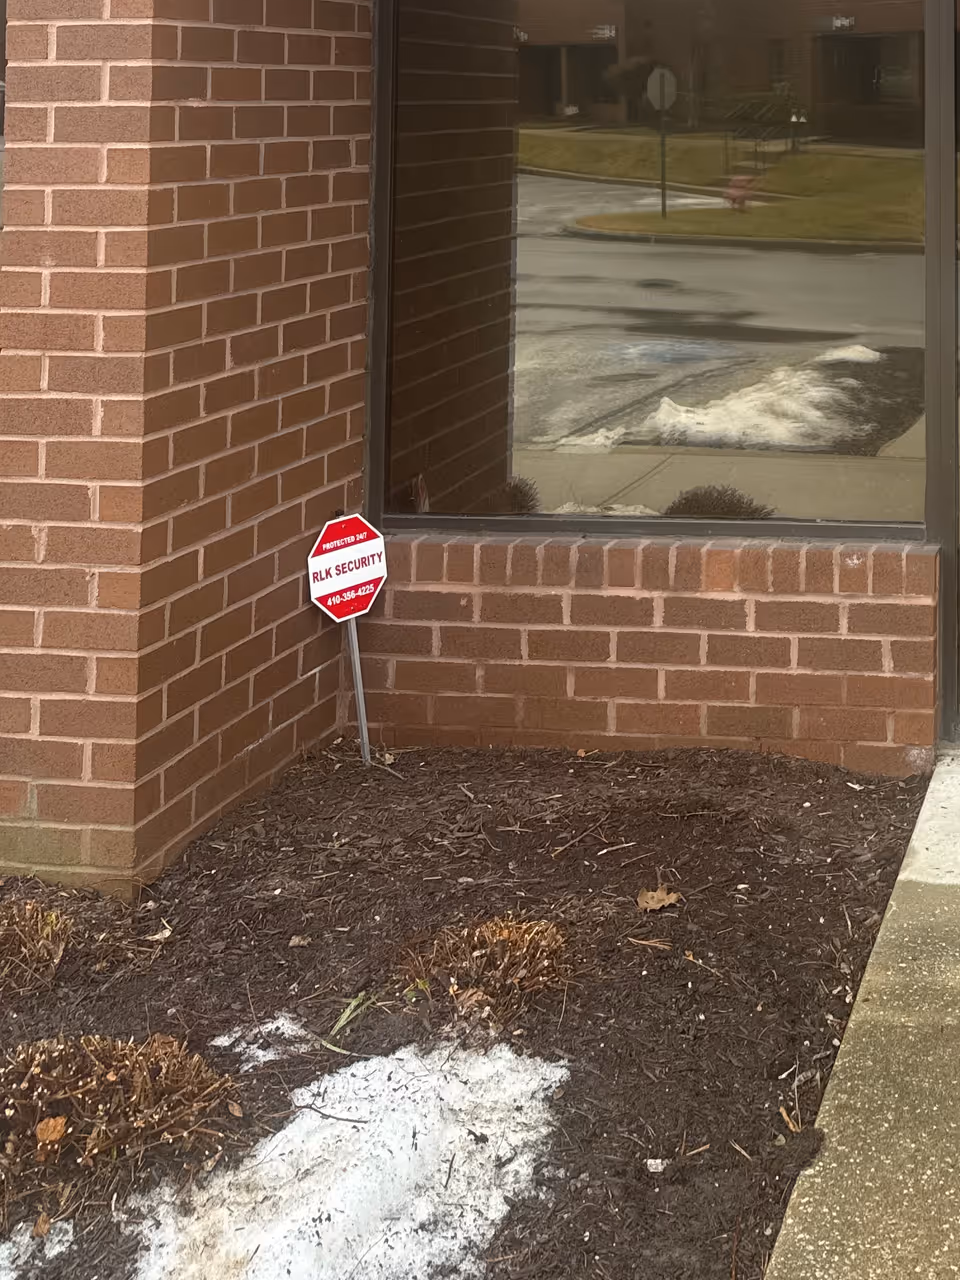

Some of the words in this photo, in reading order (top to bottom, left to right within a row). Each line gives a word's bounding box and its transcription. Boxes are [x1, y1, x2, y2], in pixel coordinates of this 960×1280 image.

[322, 535, 355, 551] PROTECTED
[355, 531, 368, 541] 24/7
[312, 566, 333, 584] RLK
[334, 551, 383, 577] SECURITY
[326, 583, 375, 606] 410-356-4225
